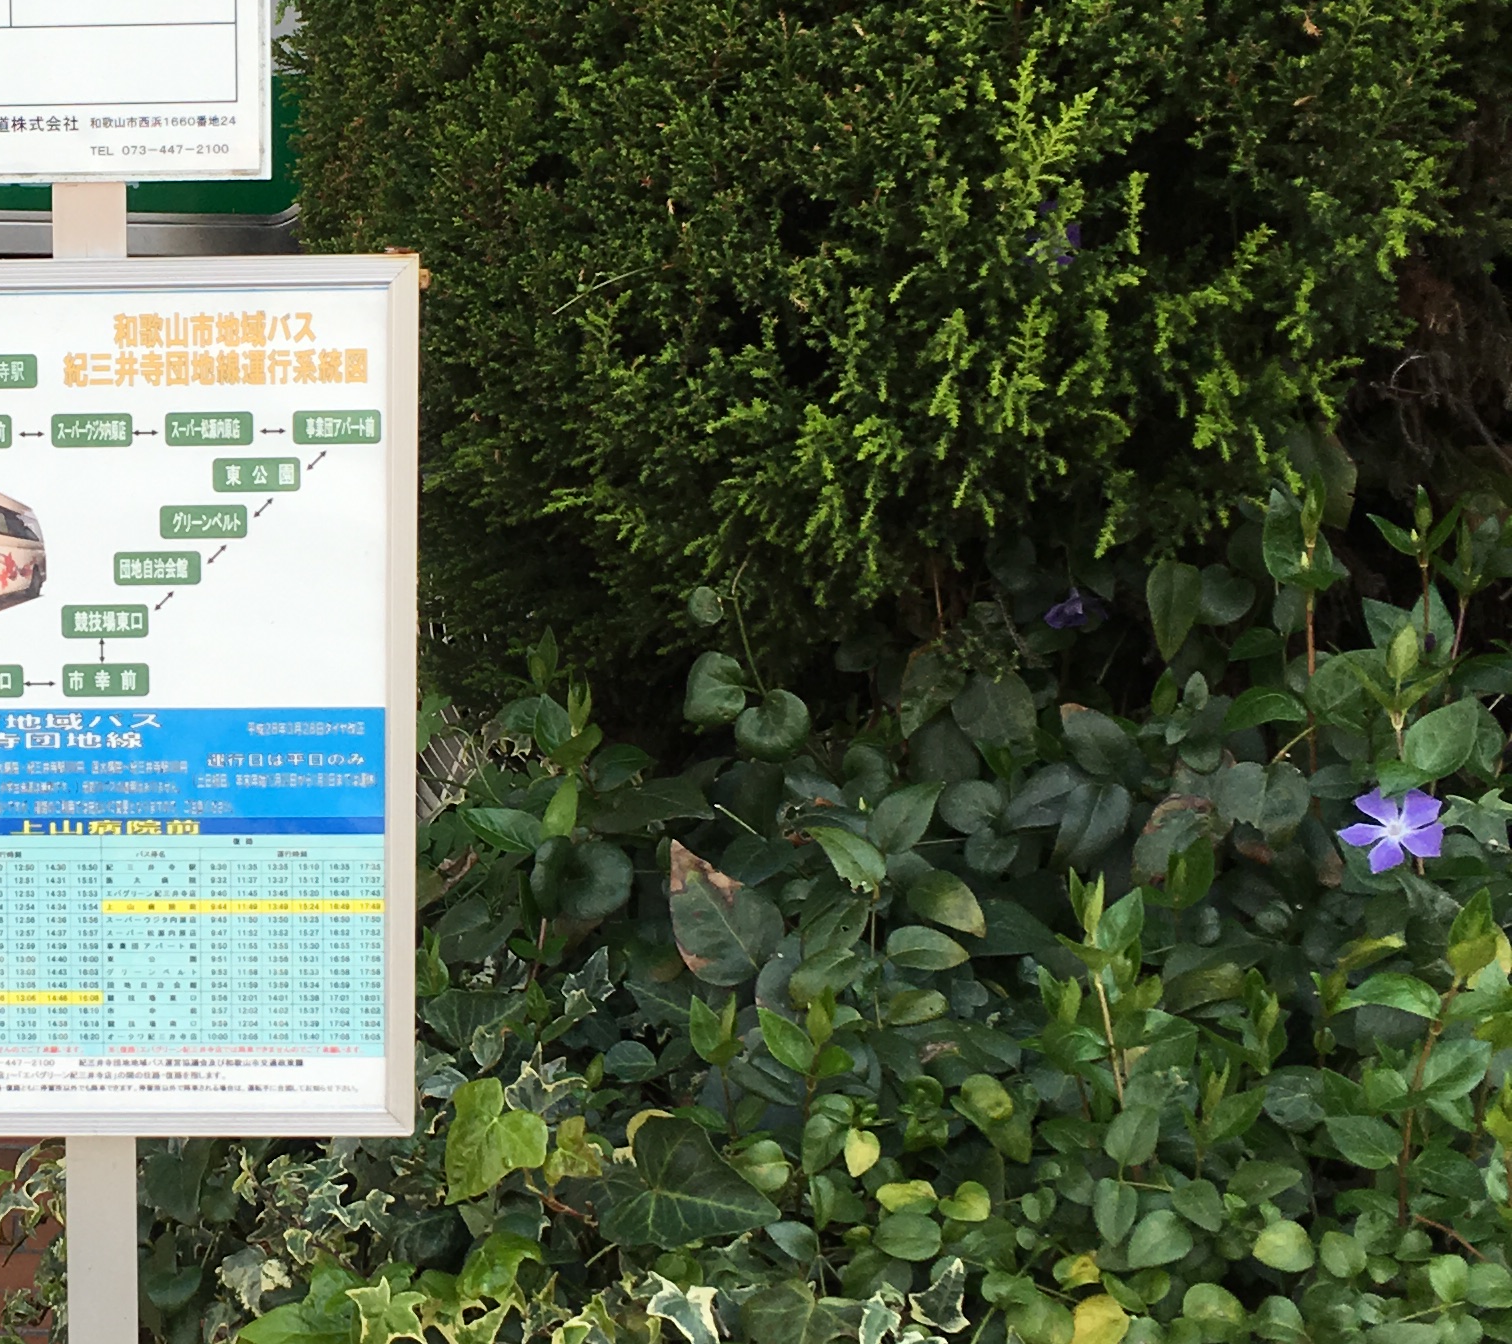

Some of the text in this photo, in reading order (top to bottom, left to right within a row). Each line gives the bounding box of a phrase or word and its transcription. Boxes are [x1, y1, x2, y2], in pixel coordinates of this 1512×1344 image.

[90, 114, 236, 129] 和歌山市西浜1660番地24
[90, 146, 115, 156] TEL
[113, 310, 317, 349] 和歌山市地域バス
[63, 348, 368, 387] 紀三井寺団地線運行系統図
[224, 462, 295, 487] 東公園
[172, 511, 242, 534] グリーンベルト
[118, 558, 189, 580] 団地自治会館
[73, 610, 144, 633] 競技場東口
[207, 753, 365, 767] 運行日は平日のみ
[10, 819, 201, 835] 上山病院前
